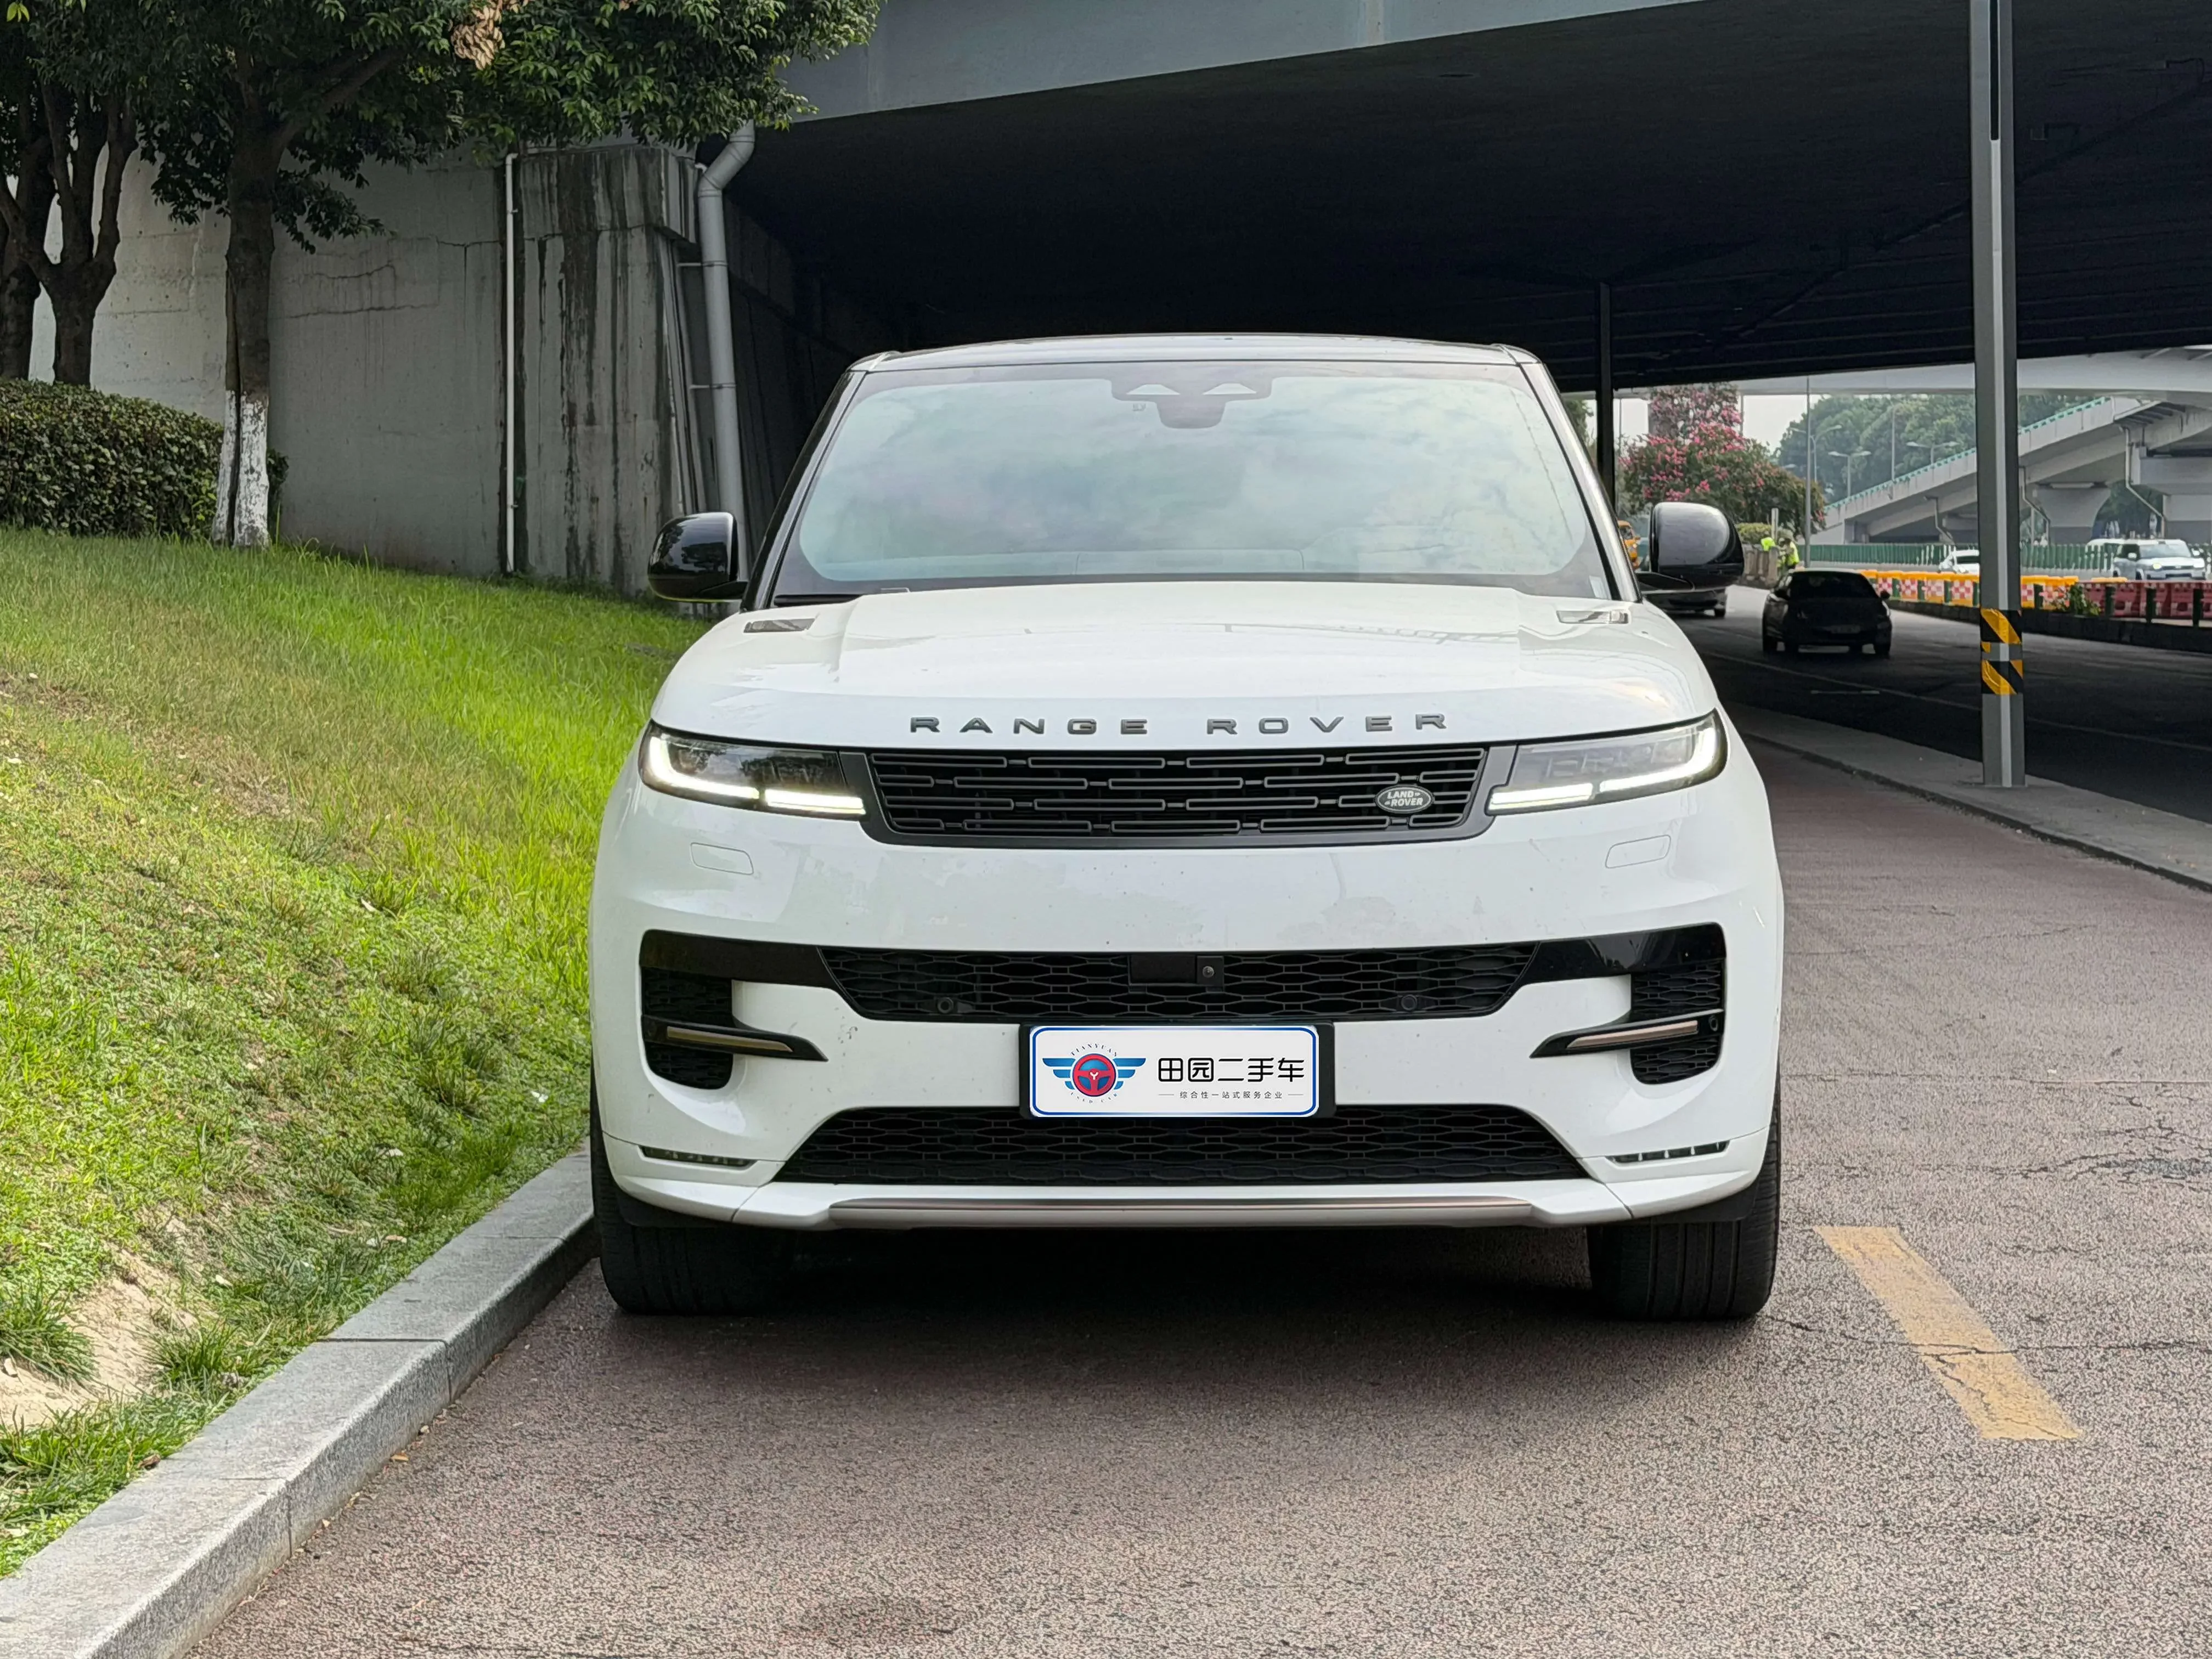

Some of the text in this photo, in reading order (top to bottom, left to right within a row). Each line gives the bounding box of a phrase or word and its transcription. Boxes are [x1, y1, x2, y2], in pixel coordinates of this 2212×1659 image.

[910, 713, 1447, 735] RANGE ROVER
[1386, 790, 1414, 799] LAND
[1390, 797, 1424, 807] ROVER
